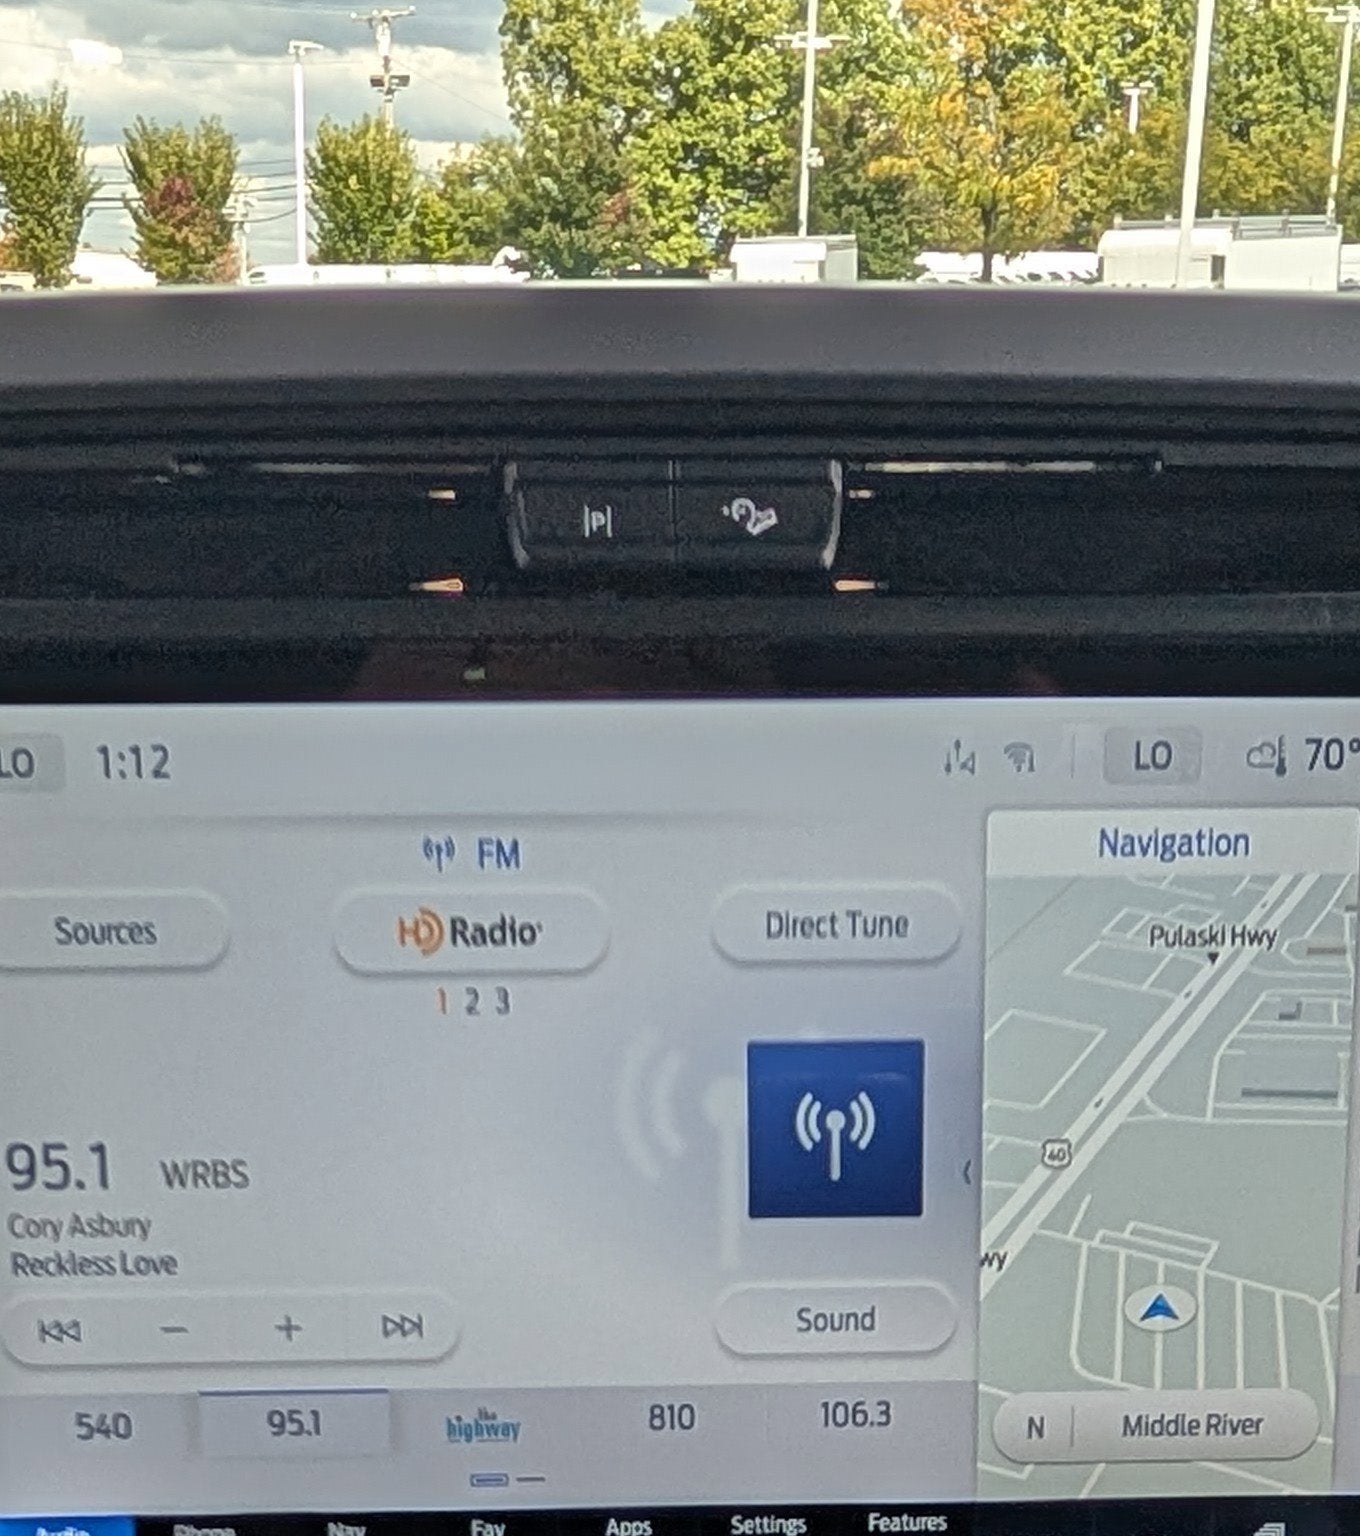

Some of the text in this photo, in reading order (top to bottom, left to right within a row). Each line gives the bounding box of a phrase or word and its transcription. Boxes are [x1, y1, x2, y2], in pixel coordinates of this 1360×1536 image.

[96, 743, 172, 781] 1:12
[1134, 739, 1173, 771] LO
[477, 836, 522, 870] FM
[1097, 827, 1251, 862] Navigation
[53, 915, 158, 948] Sources
[764, 909, 910, 941] Direct Tune
[1148, 920, 1279, 952] Pulaski Hwy
[437, 986, 510, 1015] 1 2 3
[4, 1140, 113, 1191] 95.1
[159, 1157, 252, 1190] WRBS
[7, 1210, 153, 1243] Cory Asbury
[11, 1250, 179, 1278] Reckless Love
[796, 1305, 877, 1333] Sound
[75, 1411, 133, 1441] 540
[266, 1408, 323, 1437] 95.1
[446, 1416, 522, 1443] highway
[648, 1404, 696, 1432] 810
[820, 1401, 892, 1428] 106.3
[1026, 1415, 1045, 1440] N
[1121, 1412, 1264, 1440] Middle River
[867, 1514, 949, 1536] Features
